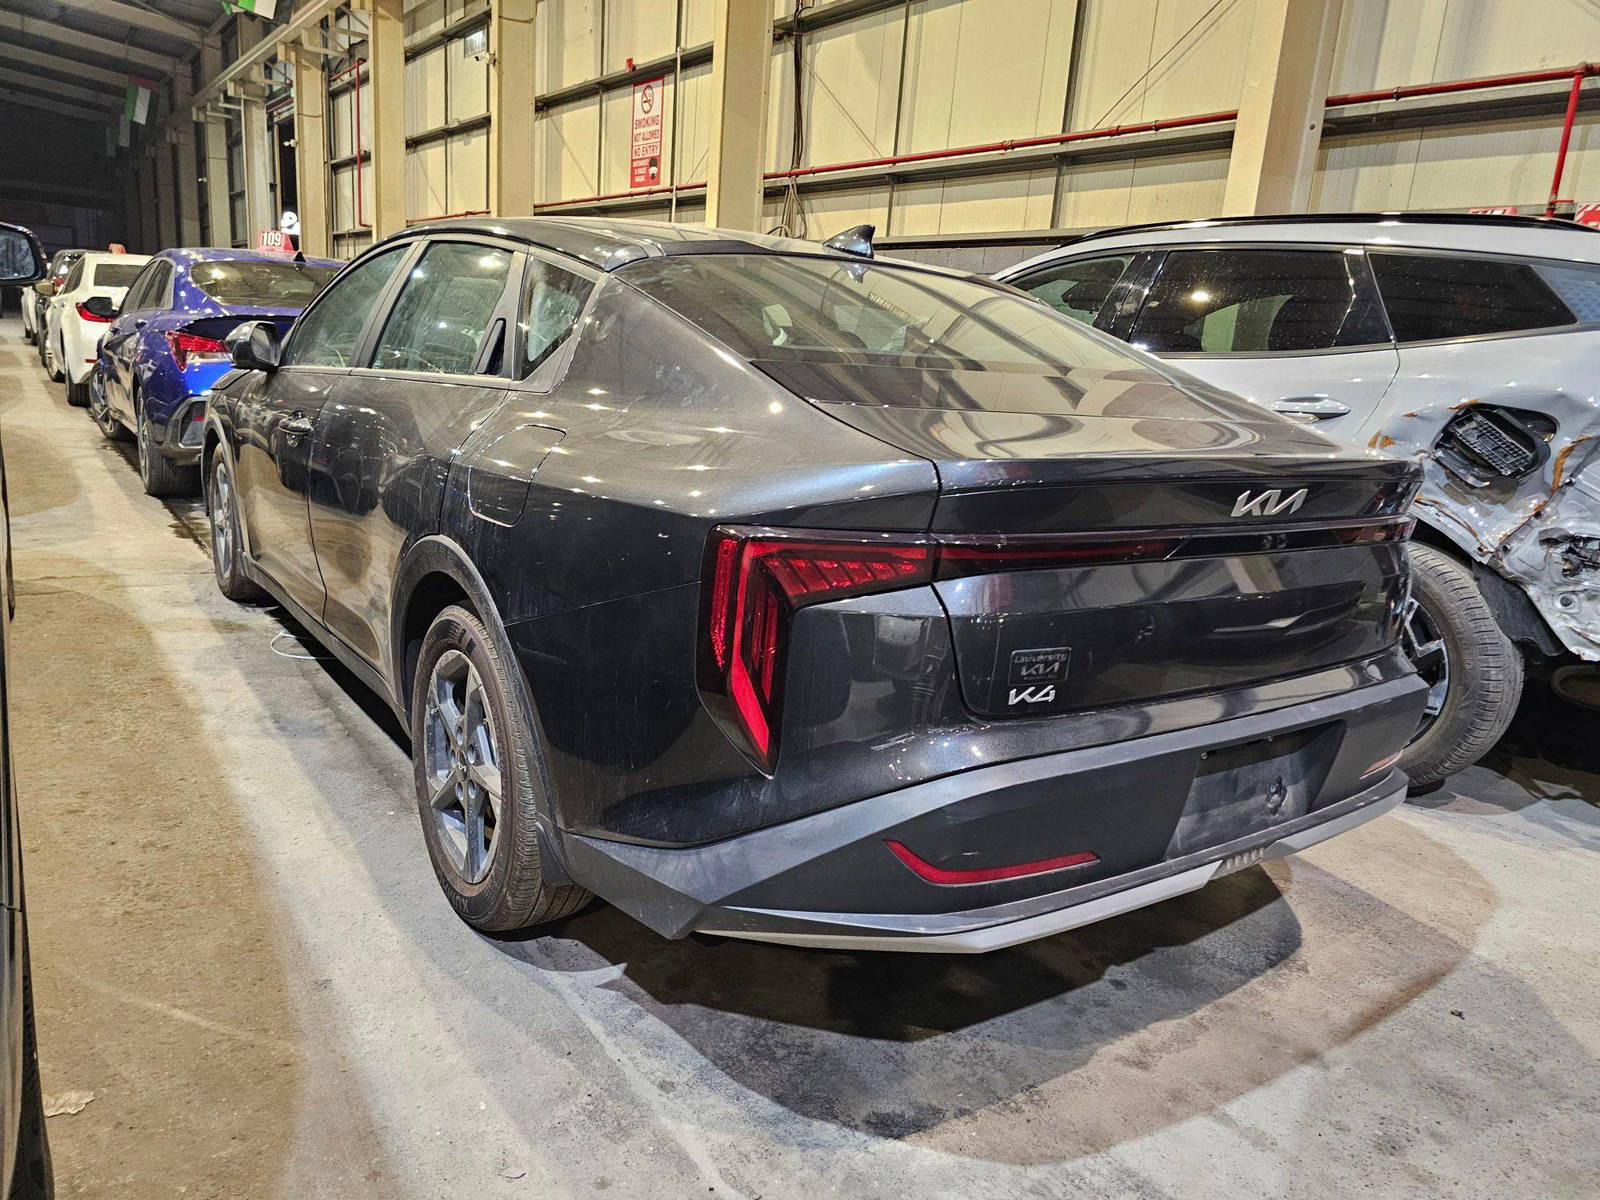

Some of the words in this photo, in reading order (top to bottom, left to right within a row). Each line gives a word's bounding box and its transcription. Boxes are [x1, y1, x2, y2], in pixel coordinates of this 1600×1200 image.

[634, 115, 659, 130] SMOKING
[634, 146, 641, 157] NO
[642, 144, 658, 156] ENTRY
[262, 232, 282, 246] 109
[1230, 488, 1309, 517] KIA
[1014, 653, 1067, 663] University
[1021, 662, 1060, 676] KIA
[1008, 685, 1056, 706] K4
